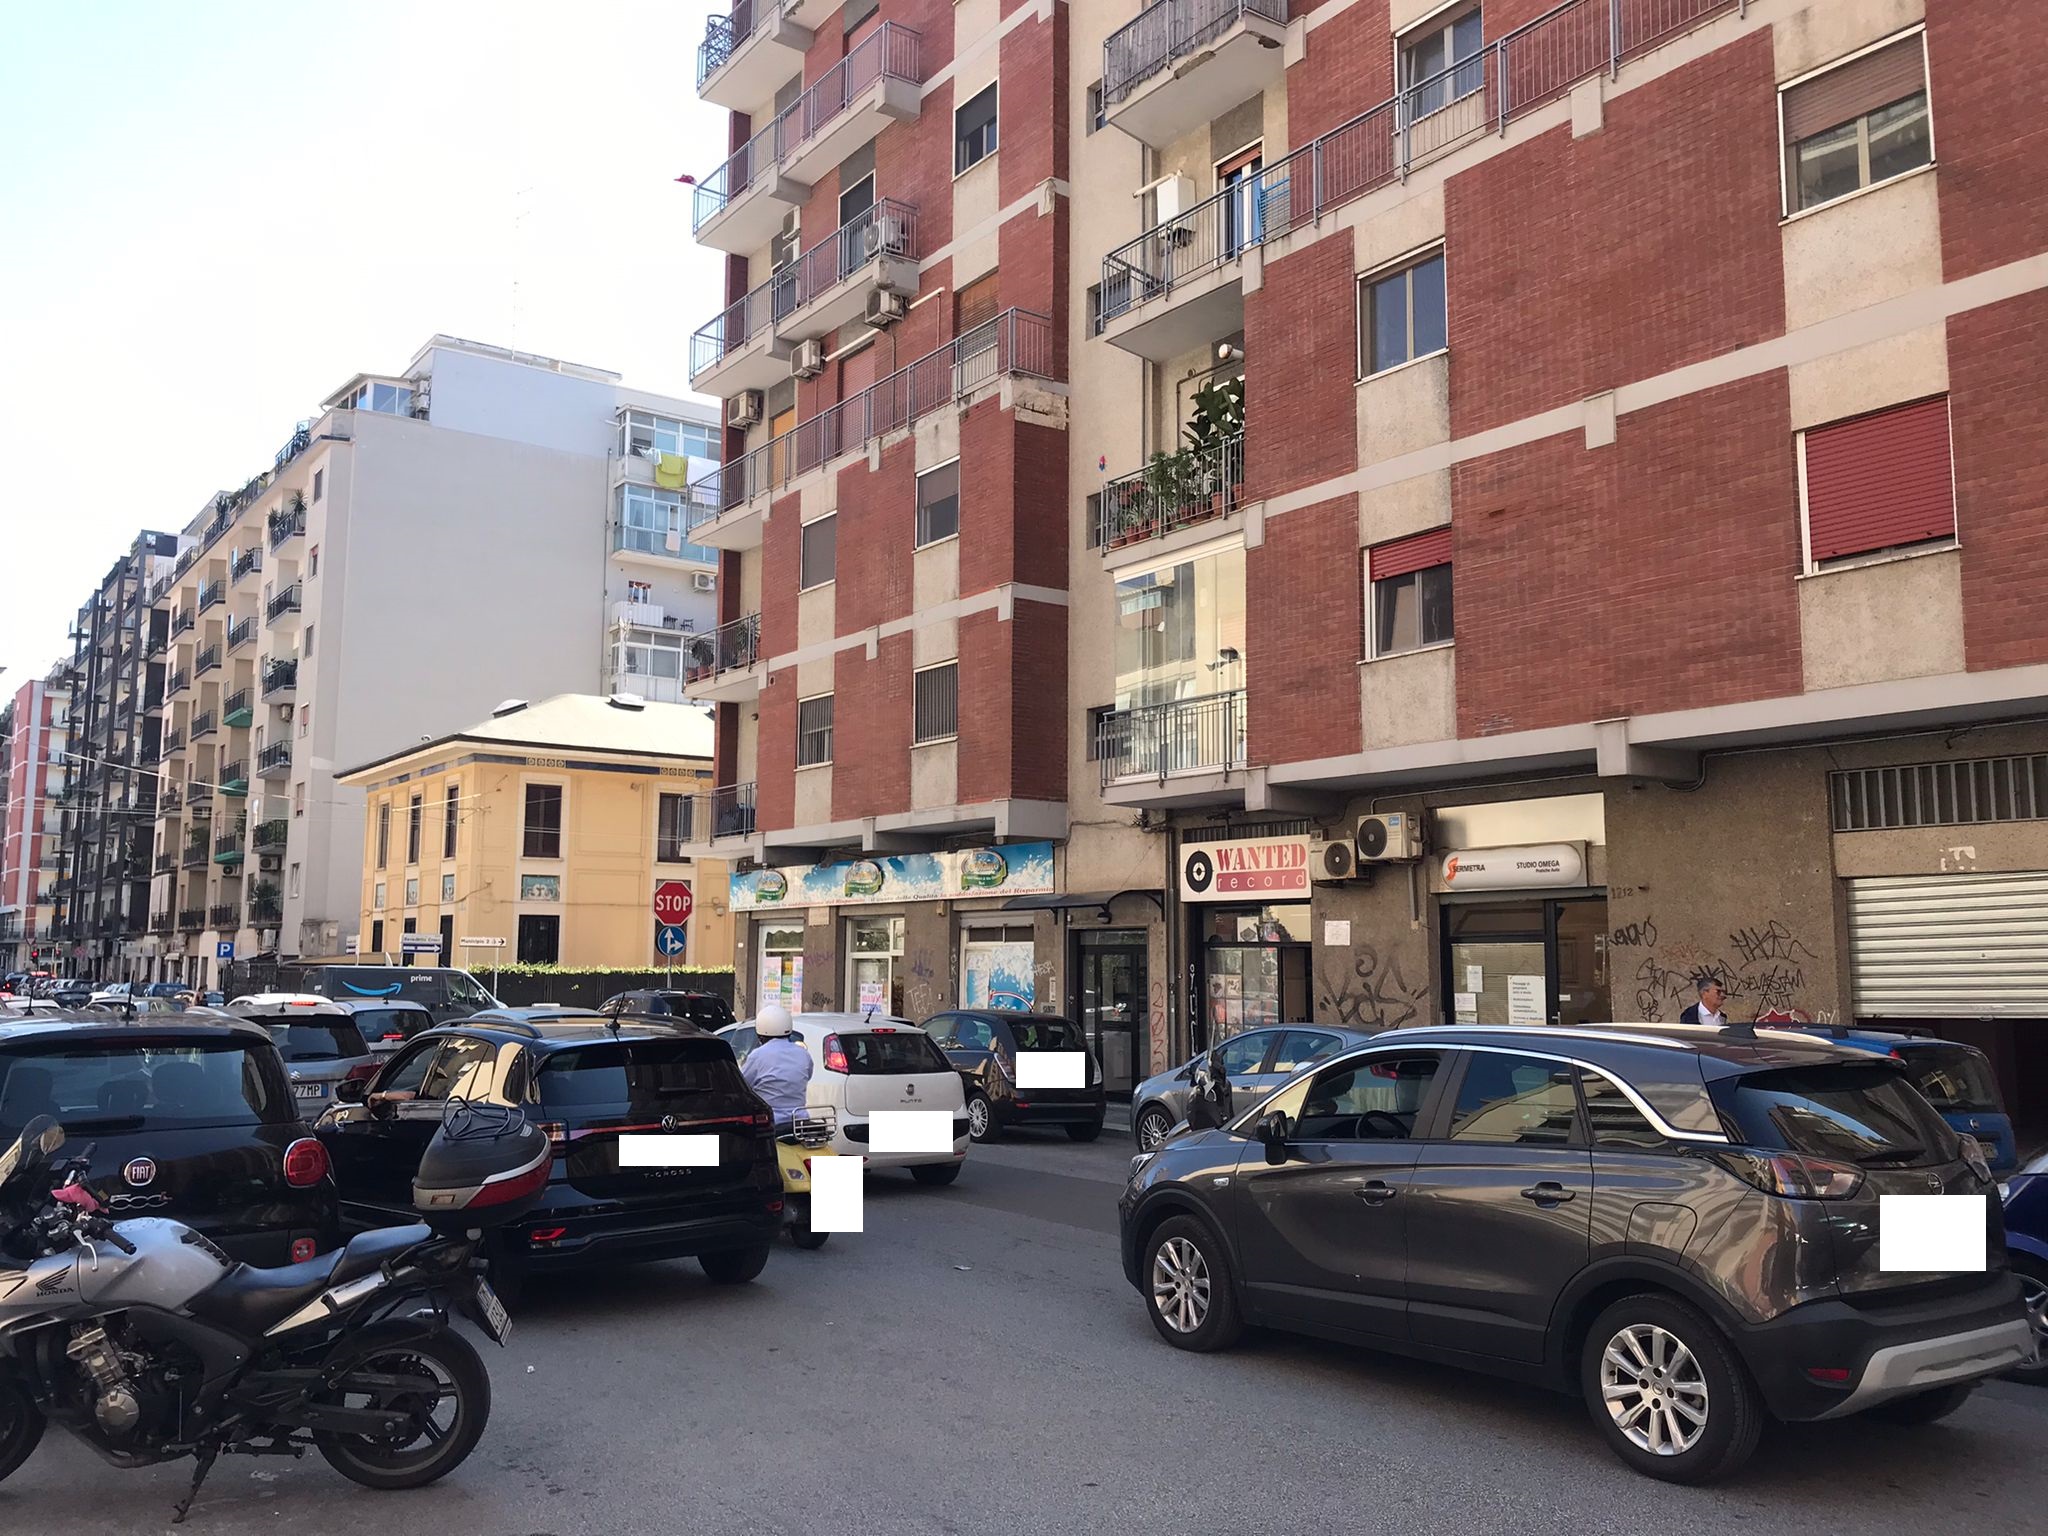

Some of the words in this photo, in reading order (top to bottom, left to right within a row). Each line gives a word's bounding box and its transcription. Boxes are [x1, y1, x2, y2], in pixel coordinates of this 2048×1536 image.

[1216, 843, 1306, 871] WANTED
[1516, 861, 1537, 869] STUDIO
[1538, 860, 1560, 868] OMEGA
[1217, 871, 1305, 889] record
[656, 895, 691, 911] STOP
[220, 943, 231, 956] P
[410, 974, 433, 983] prime
[132, 1165, 151, 1179] FIAT
[644, 1168, 692, 1178] T-CROSS
[36, 1287, 74, 1297] HONDA
